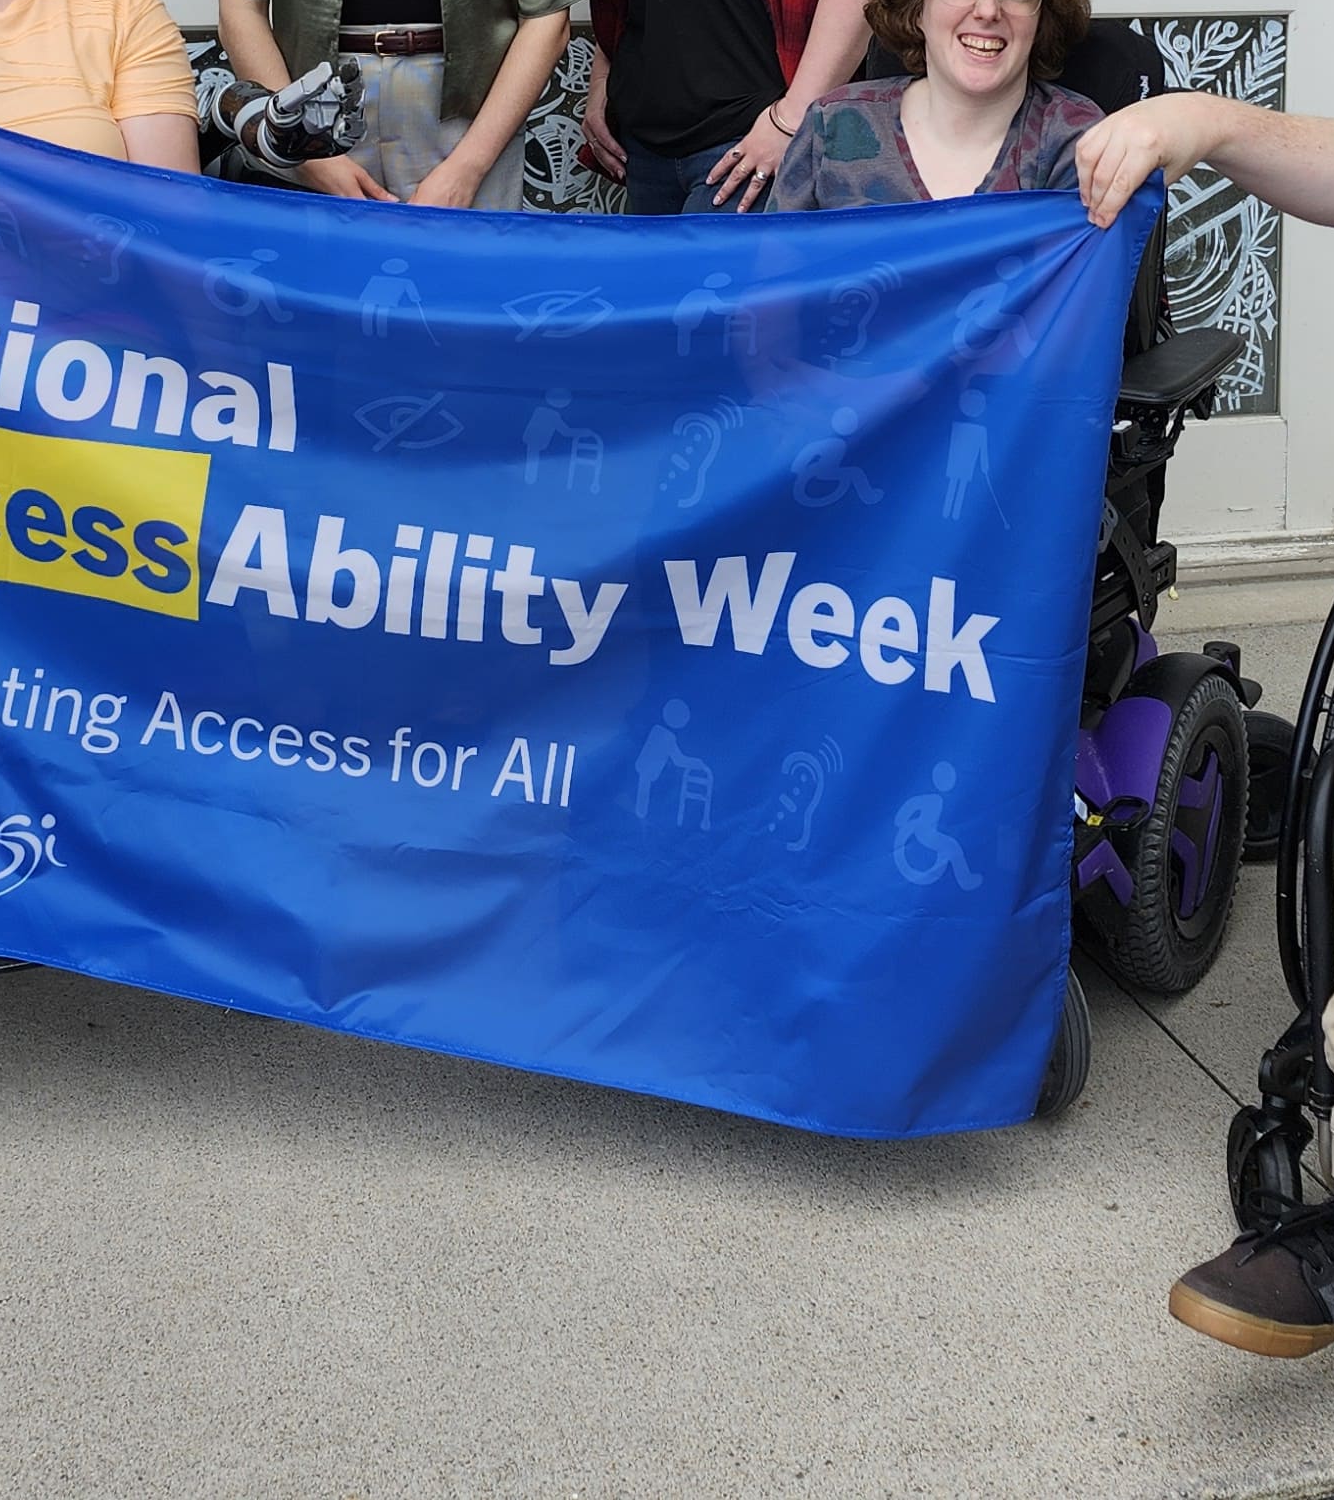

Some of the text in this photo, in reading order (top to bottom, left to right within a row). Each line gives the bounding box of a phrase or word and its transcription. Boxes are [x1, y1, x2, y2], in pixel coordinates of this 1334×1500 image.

[663, 551, 1001, 703] Week
[140, 691, 372, 778] Access
[388, 726, 478, 791] for
[490, 737, 576, 807] All
